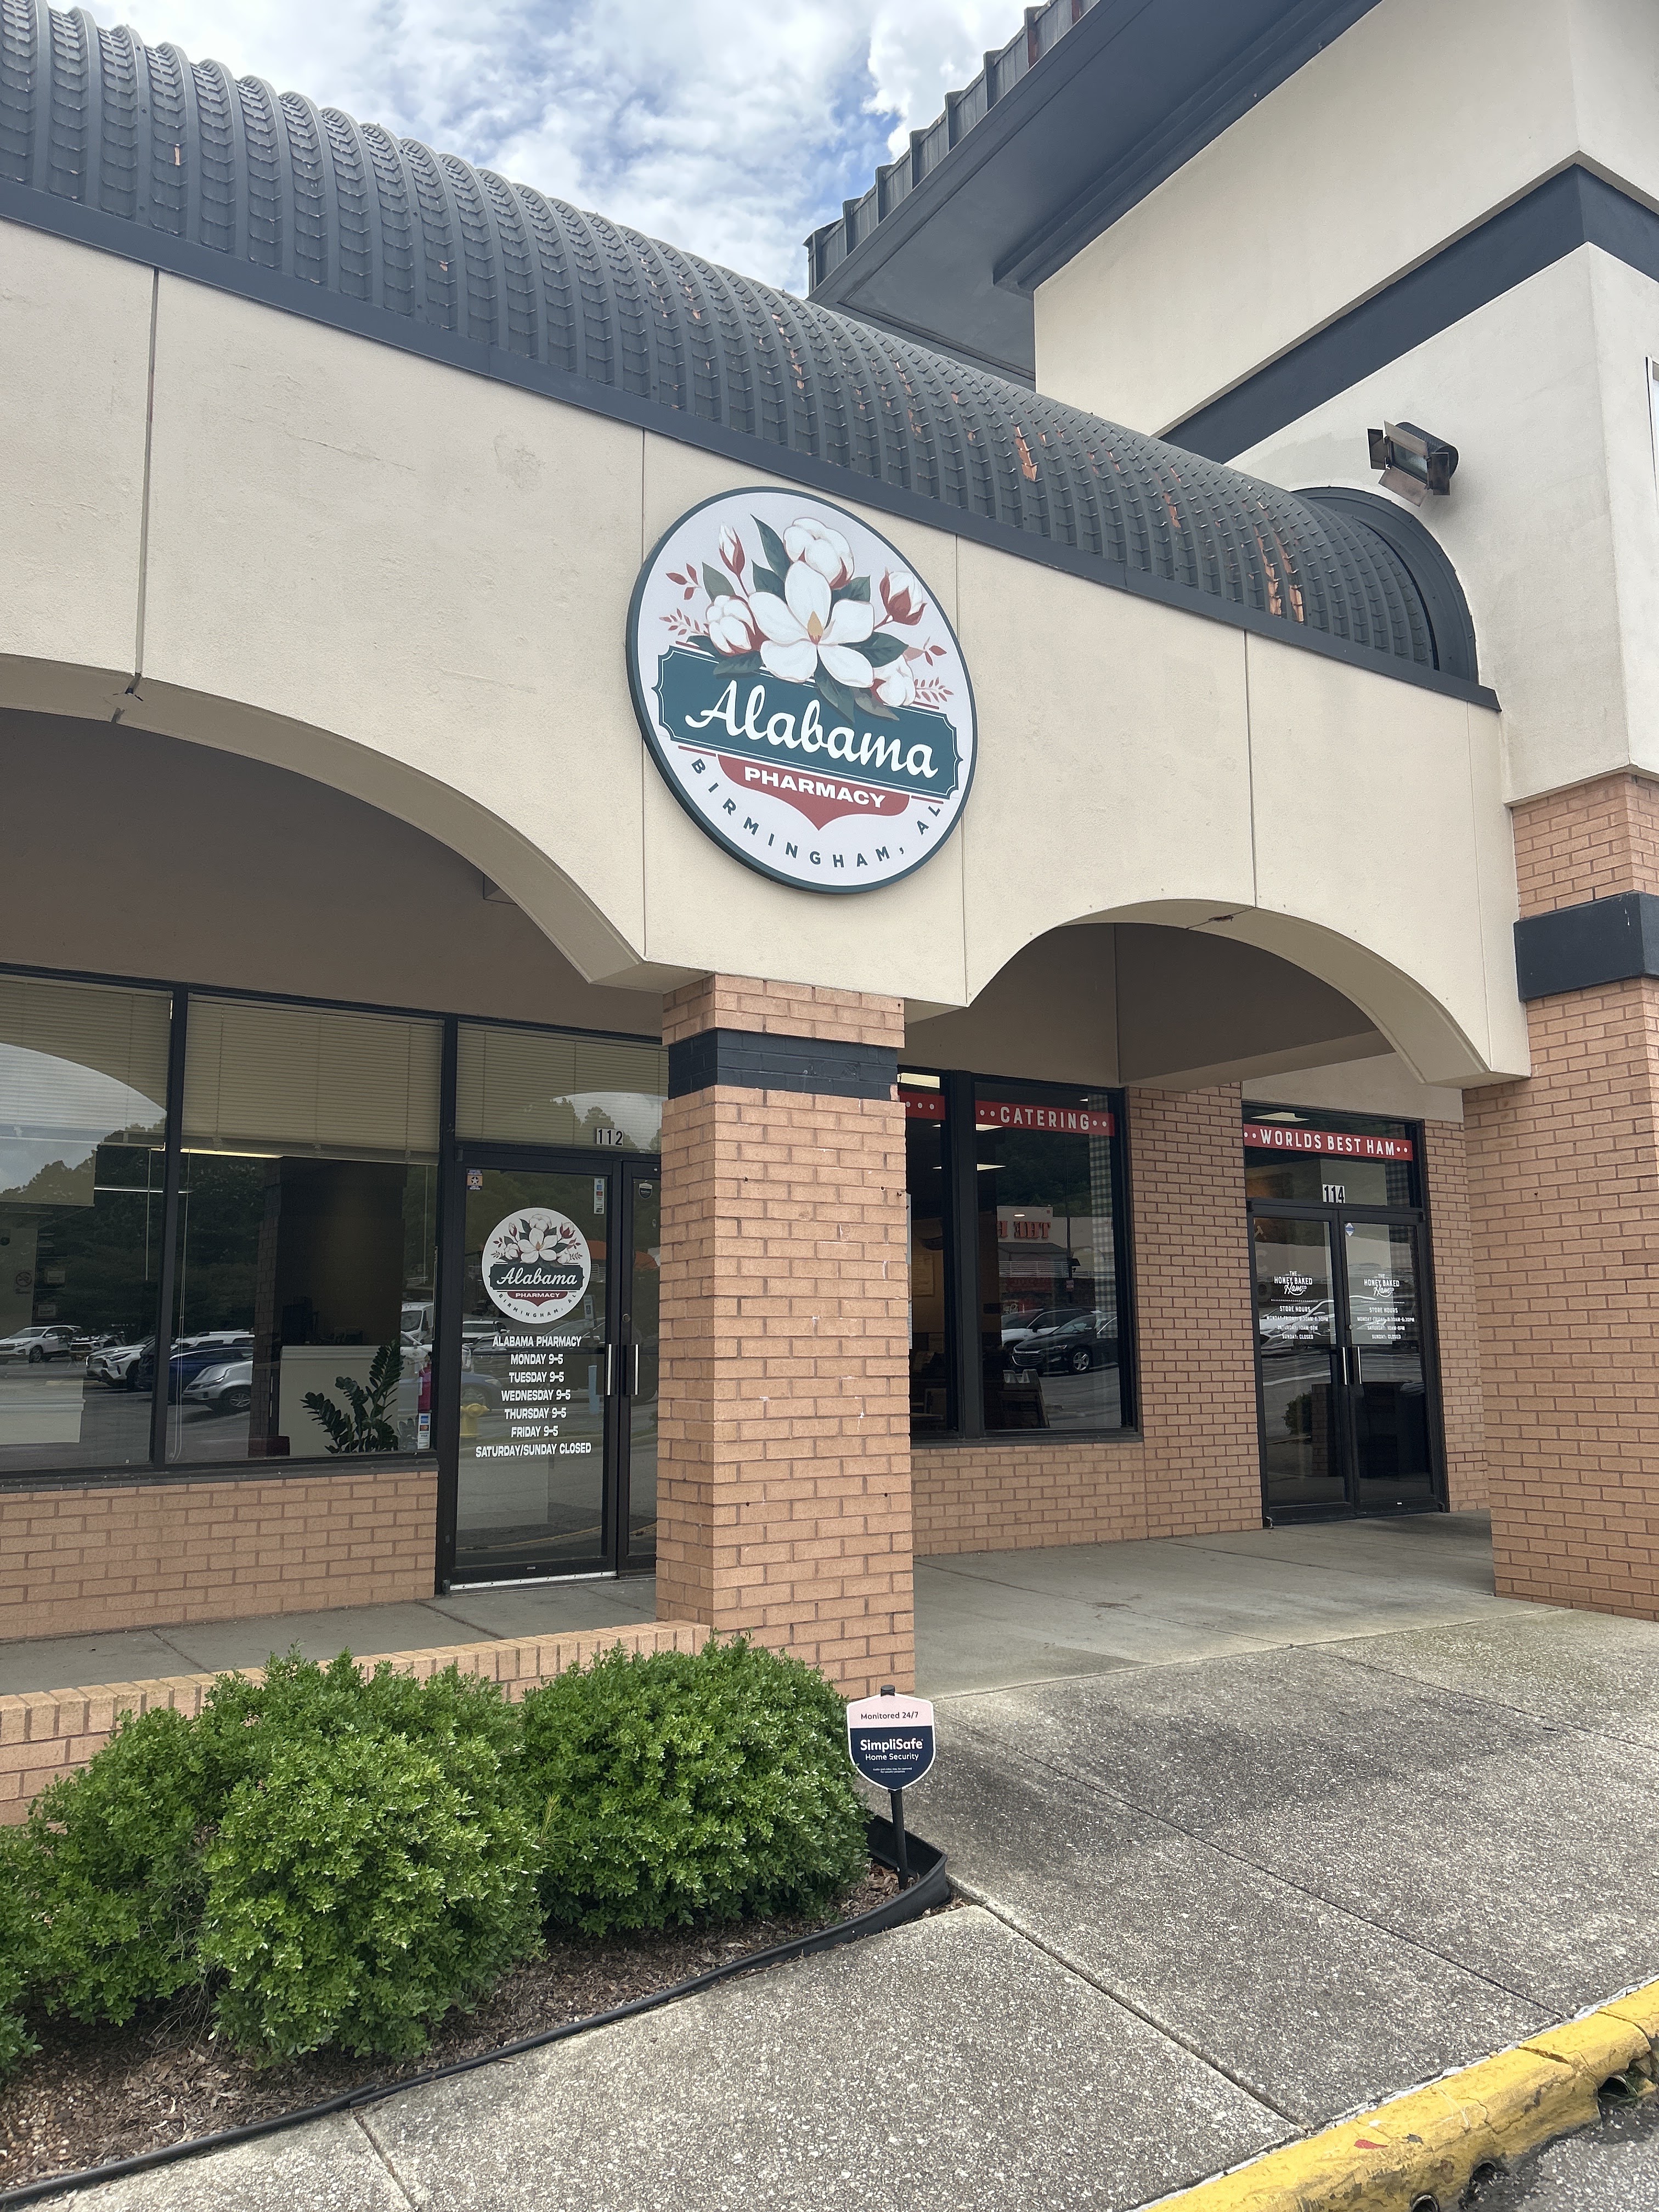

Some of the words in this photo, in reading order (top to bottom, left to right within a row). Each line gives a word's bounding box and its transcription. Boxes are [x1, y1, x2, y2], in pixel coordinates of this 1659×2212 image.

[685, 679, 938, 778] Alabama
[744, 766, 885, 809] PHARMACY
[692, 758, 905, 868] BIRMINGHAM,
[917, 804, 940, 834] AL
[1000, 1107, 1089, 1130] CATERING
[599, 1129, 623, 1146] 112
[1260, 1129, 1321, 1149] WORLDS
[1328, 1136, 1361, 1153] BEST
[1367, 1139, 1395, 1156] HAM
[1324, 1186, 1344, 1203] 114
[496, 1267, 577, 1285] Alabama
[568, 1295, 576, 1303] AL
[493, 1336, 534, 1346] ALABAMA
[536, 1336, 582, 1347] PHARMACY
[511, 1354, 546, 1364] MONDAY
[549, 1353, 563, 1364] 9-5
[509, 1372, 547, 1383] TUESDAY
[549, 1372, 565, 1383] 9-5
[501, 1390, 554, 1401] WEDNESDAY
[556, 1389, 571, 1400] 9-5
[505, 1408, 550, 1419] THURSDAY
[551, 1407, 567, 1418] 9-5
[511, 1426, 541, 1437] FRIDAY
[543, 1425, 558, 1436] 9-5
[476, 1443, 557, 1457] SATURDAY/SUNDAY
[560, 1442, 591, 1454] CLOSED
[860, 1738, 923, 1753] SimpliSafe
[889, 1752, 919, 1760] Security
